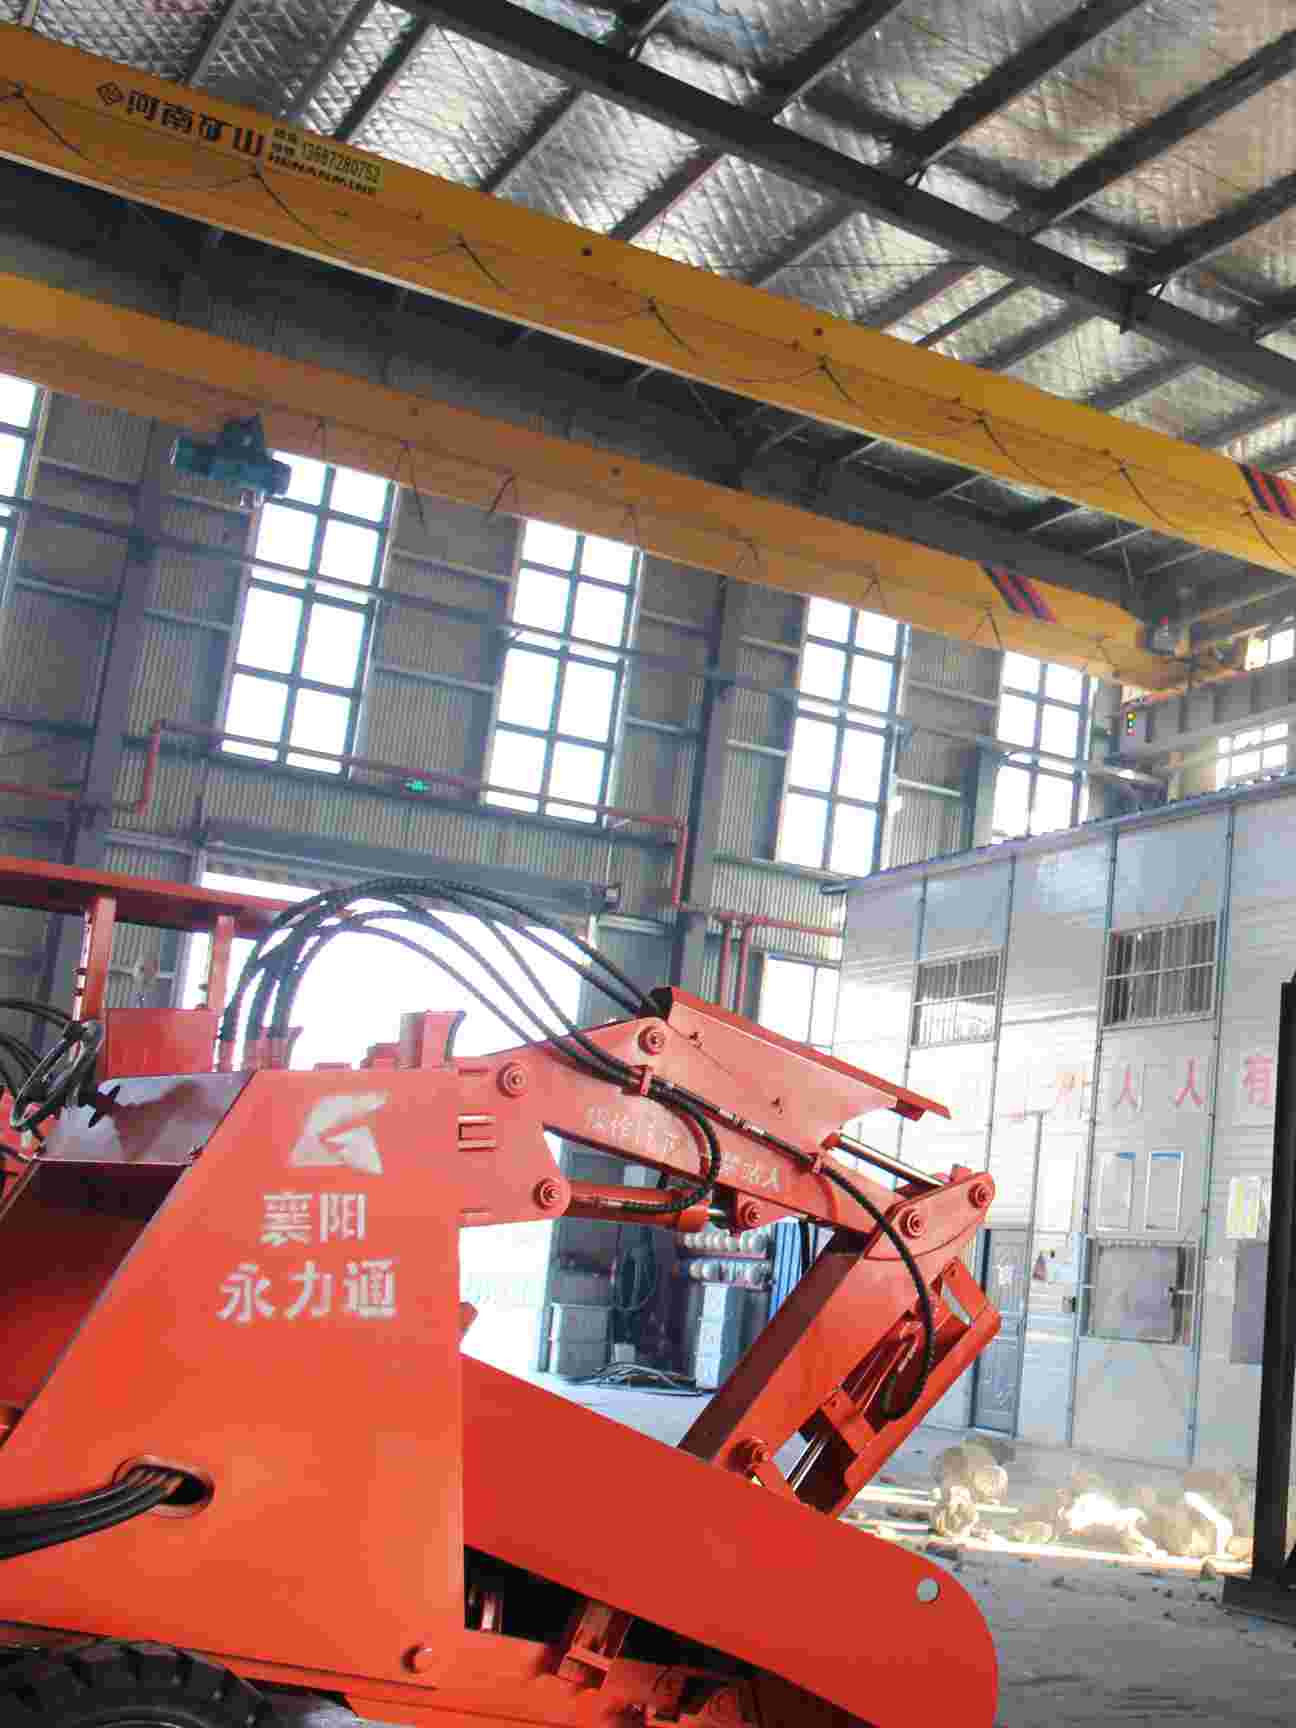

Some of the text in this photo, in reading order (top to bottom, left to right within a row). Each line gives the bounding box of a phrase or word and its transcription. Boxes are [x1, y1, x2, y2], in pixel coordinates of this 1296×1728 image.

[127, 90, 265, 157] 河南矿山
[258, 1191, 367, 1247] 襄阳
[215, 1258, 398, 1325] 永力通
